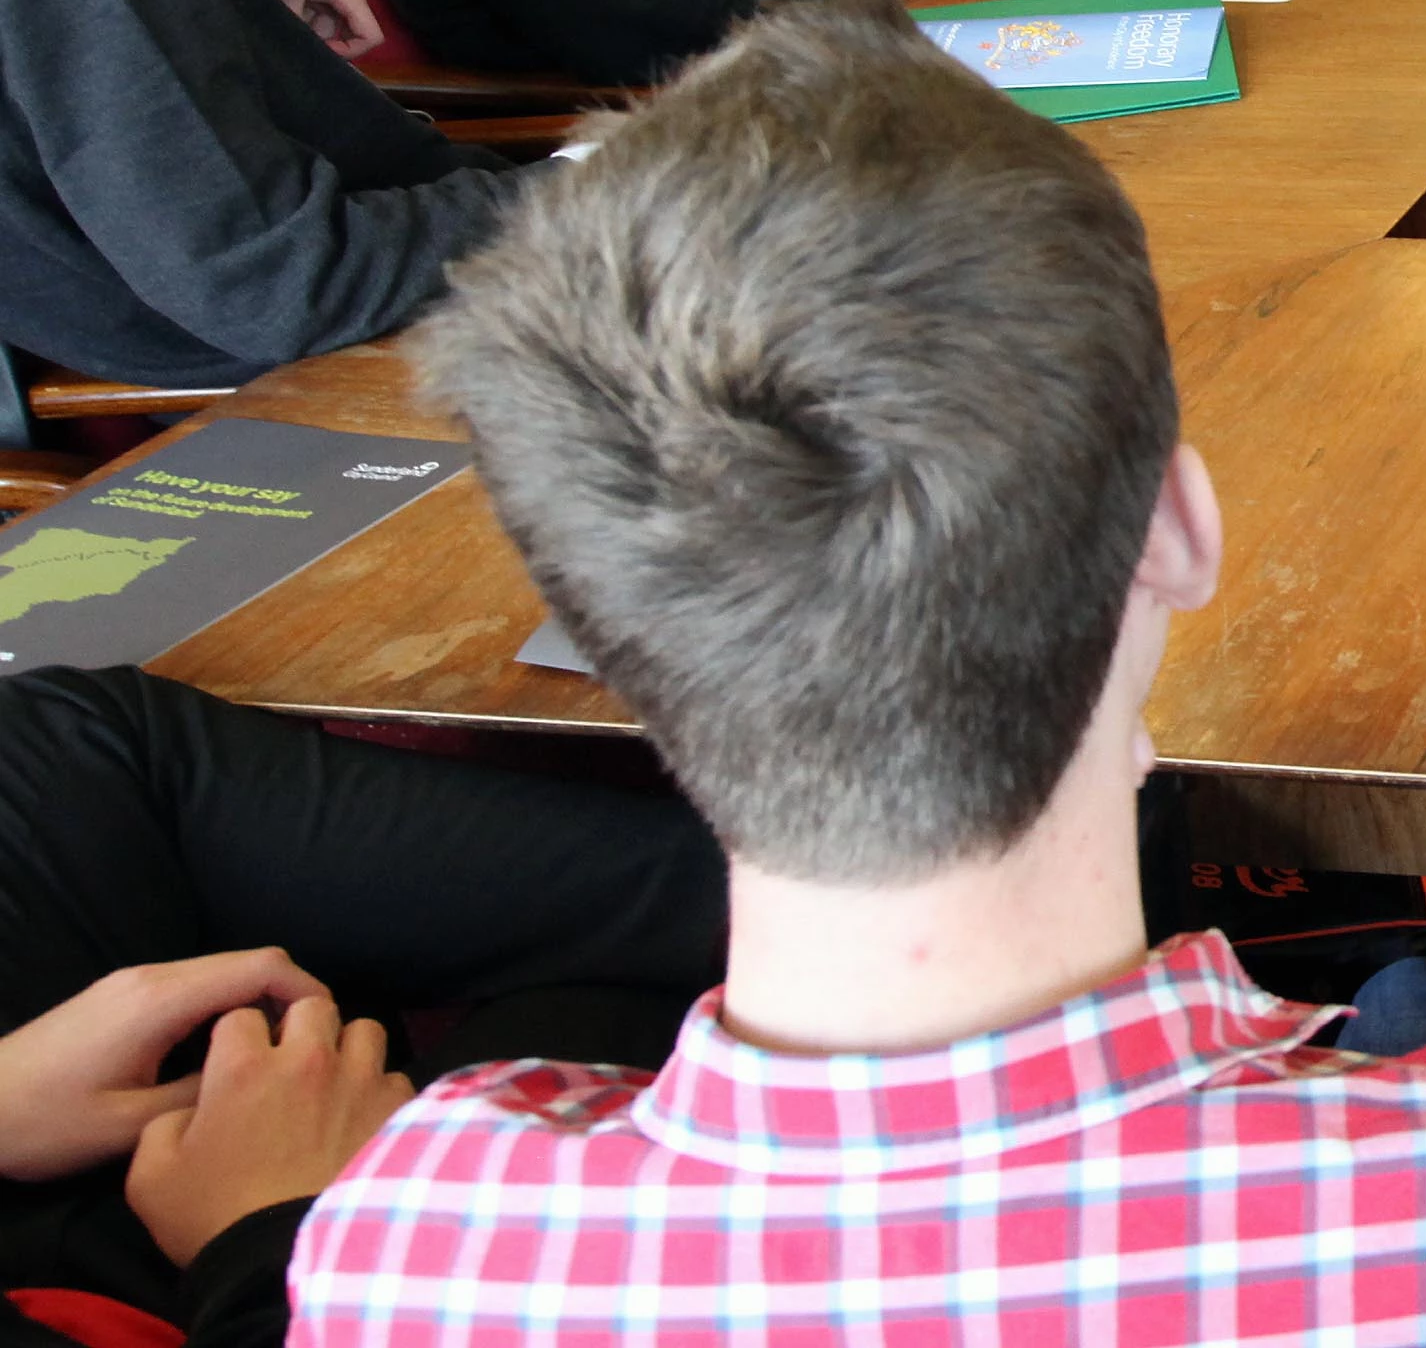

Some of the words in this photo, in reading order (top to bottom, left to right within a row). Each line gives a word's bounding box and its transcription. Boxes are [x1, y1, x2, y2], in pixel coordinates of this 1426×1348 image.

[1124, 14, 1163, 70] Freedom
[1151, 12, 1192, 68] Honorary
[134, 470, 200, 488] Have
[190, 480, 254, 497] your
[252, 489, 303, 503] say
[109, 497, 205, 519] Sunderland
[209, 501, 314, 520] development
